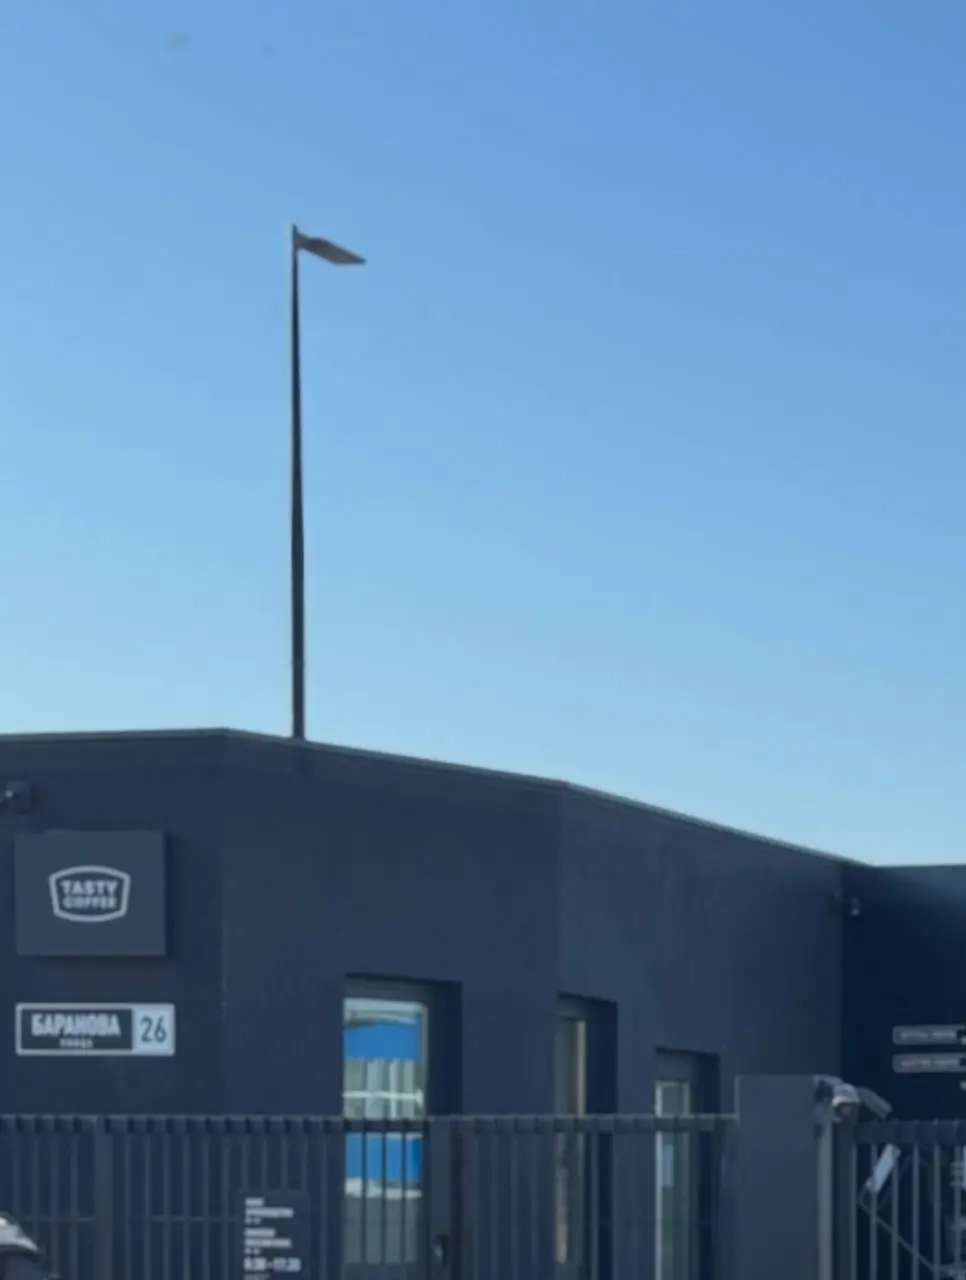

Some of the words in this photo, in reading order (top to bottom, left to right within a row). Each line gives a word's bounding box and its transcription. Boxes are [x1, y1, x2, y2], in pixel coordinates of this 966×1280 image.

[60, 879, 118, 896] TASTY
[31, 1013, 121, 1036] БАРАНОВА
[140, 1015, 168, 1044] 26
